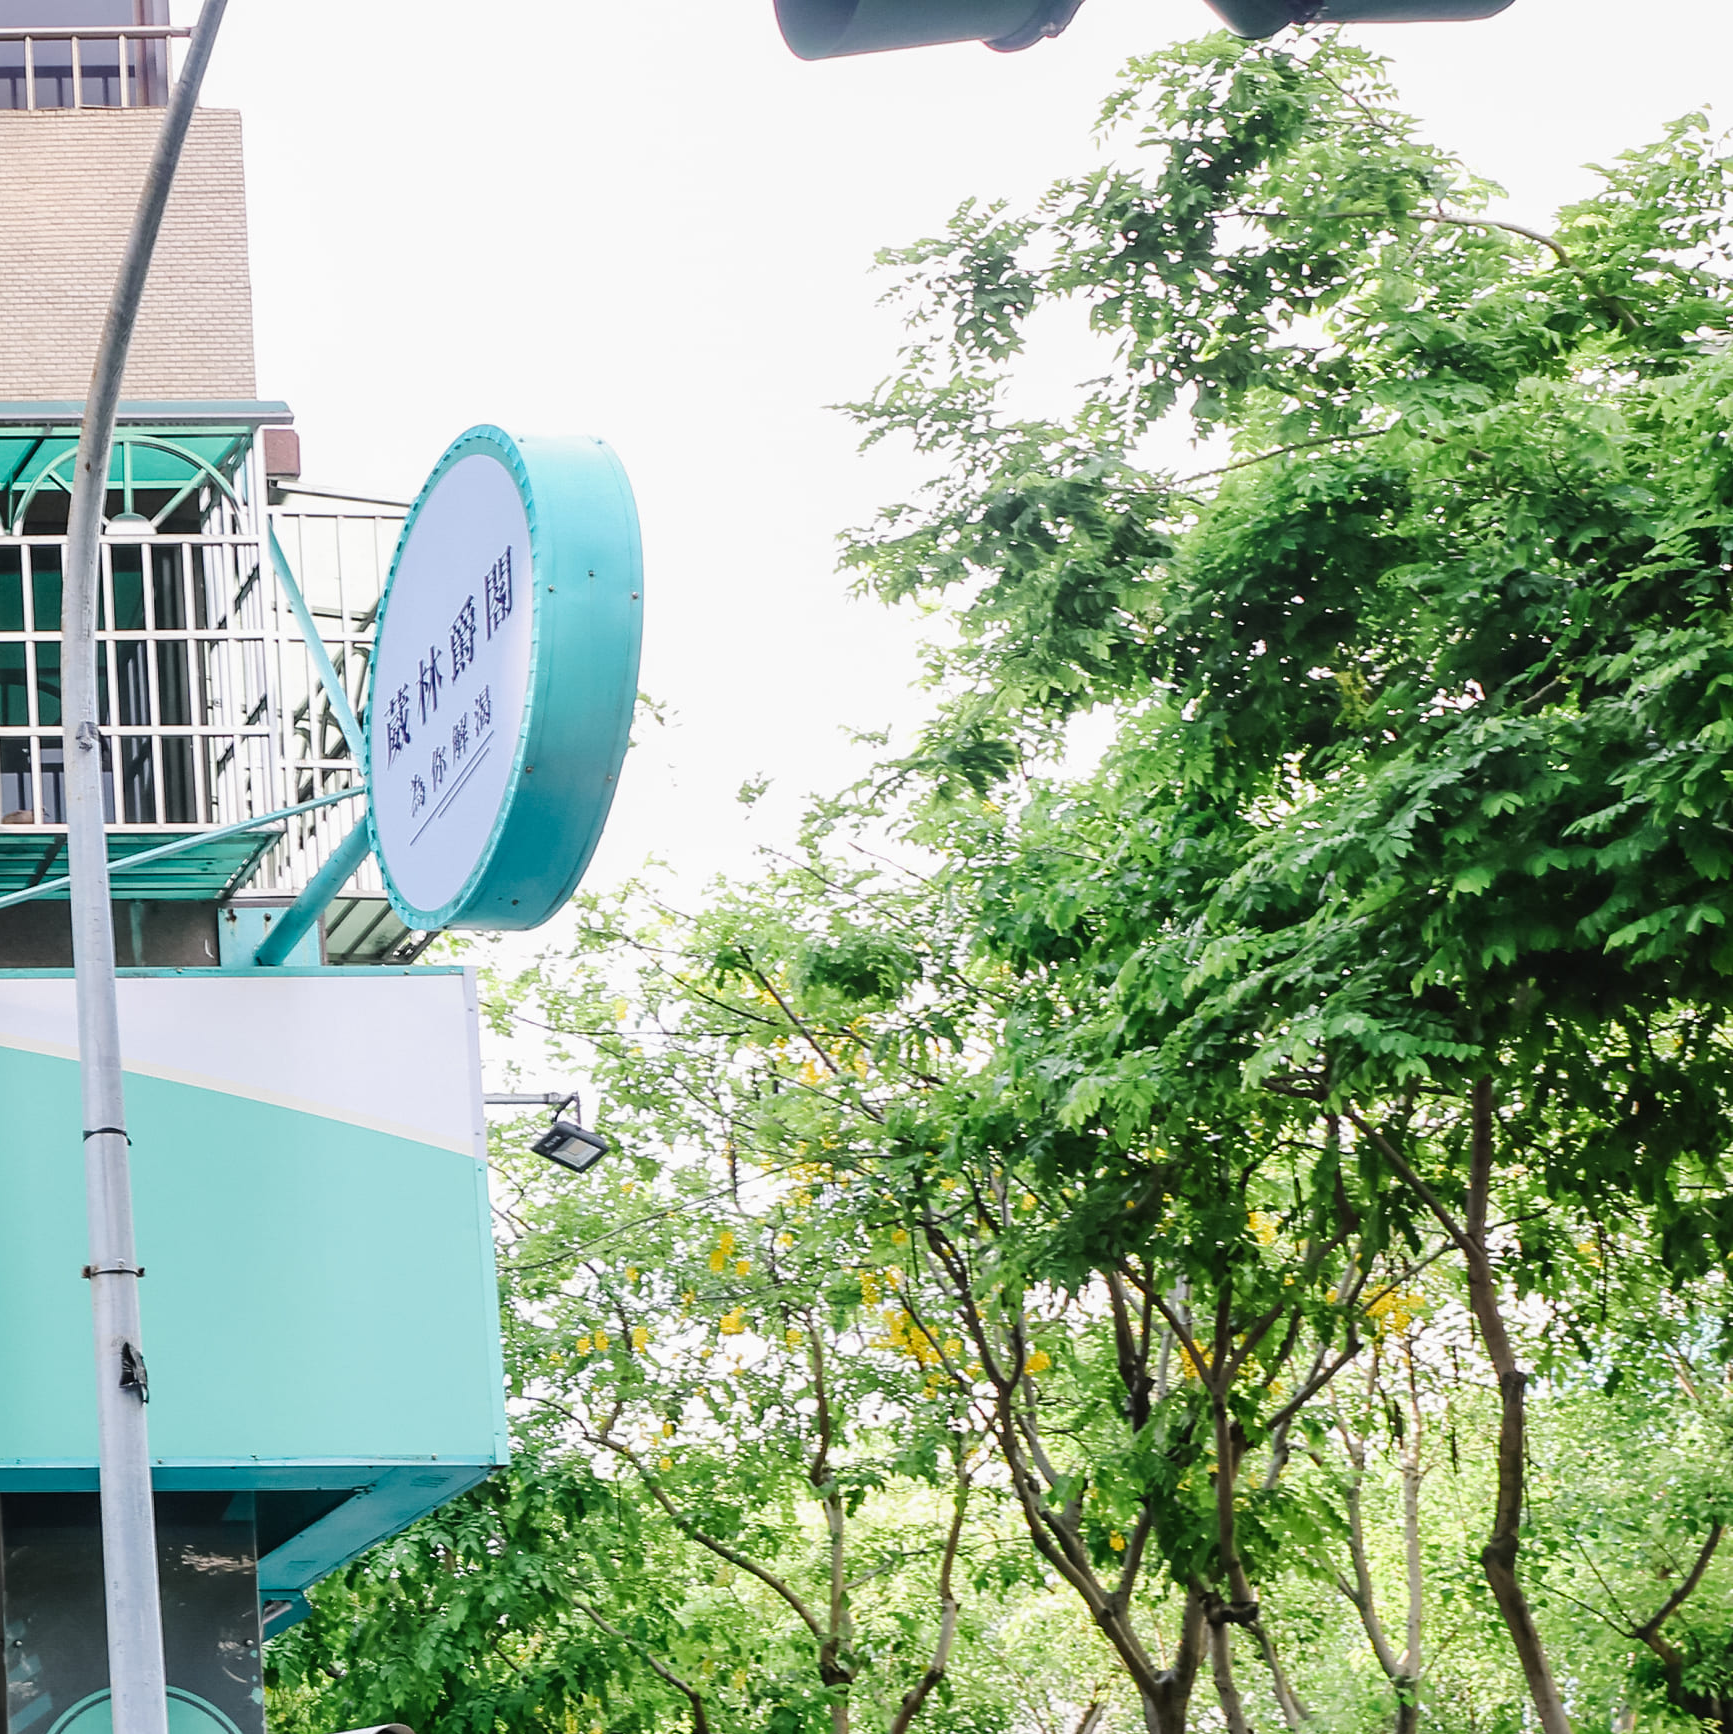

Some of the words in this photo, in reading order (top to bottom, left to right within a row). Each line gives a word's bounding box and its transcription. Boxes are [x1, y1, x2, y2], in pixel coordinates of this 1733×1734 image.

[385, 545, 513, 770] 葳林爵閣
[410, 684, 492, 819] 為你解渴
